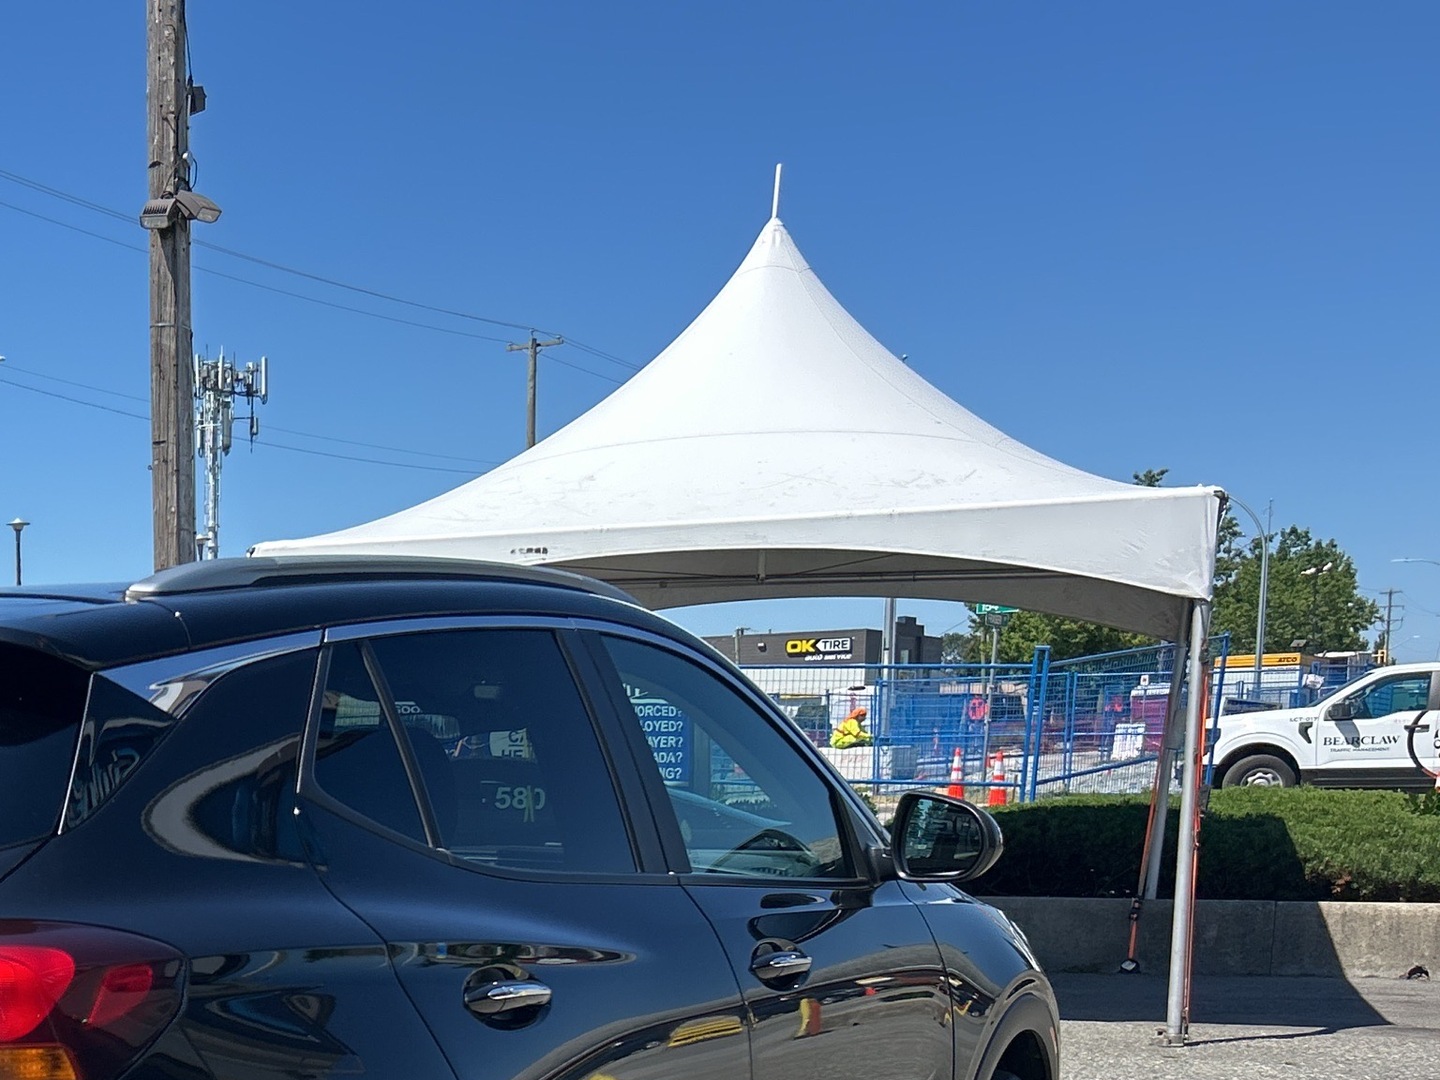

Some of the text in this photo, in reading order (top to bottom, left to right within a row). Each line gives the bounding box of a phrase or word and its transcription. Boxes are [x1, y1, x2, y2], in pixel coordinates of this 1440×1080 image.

[786, 639, 849, 653] OK TIRE
[1323, 735, 1401, 746] BEARCLAW
